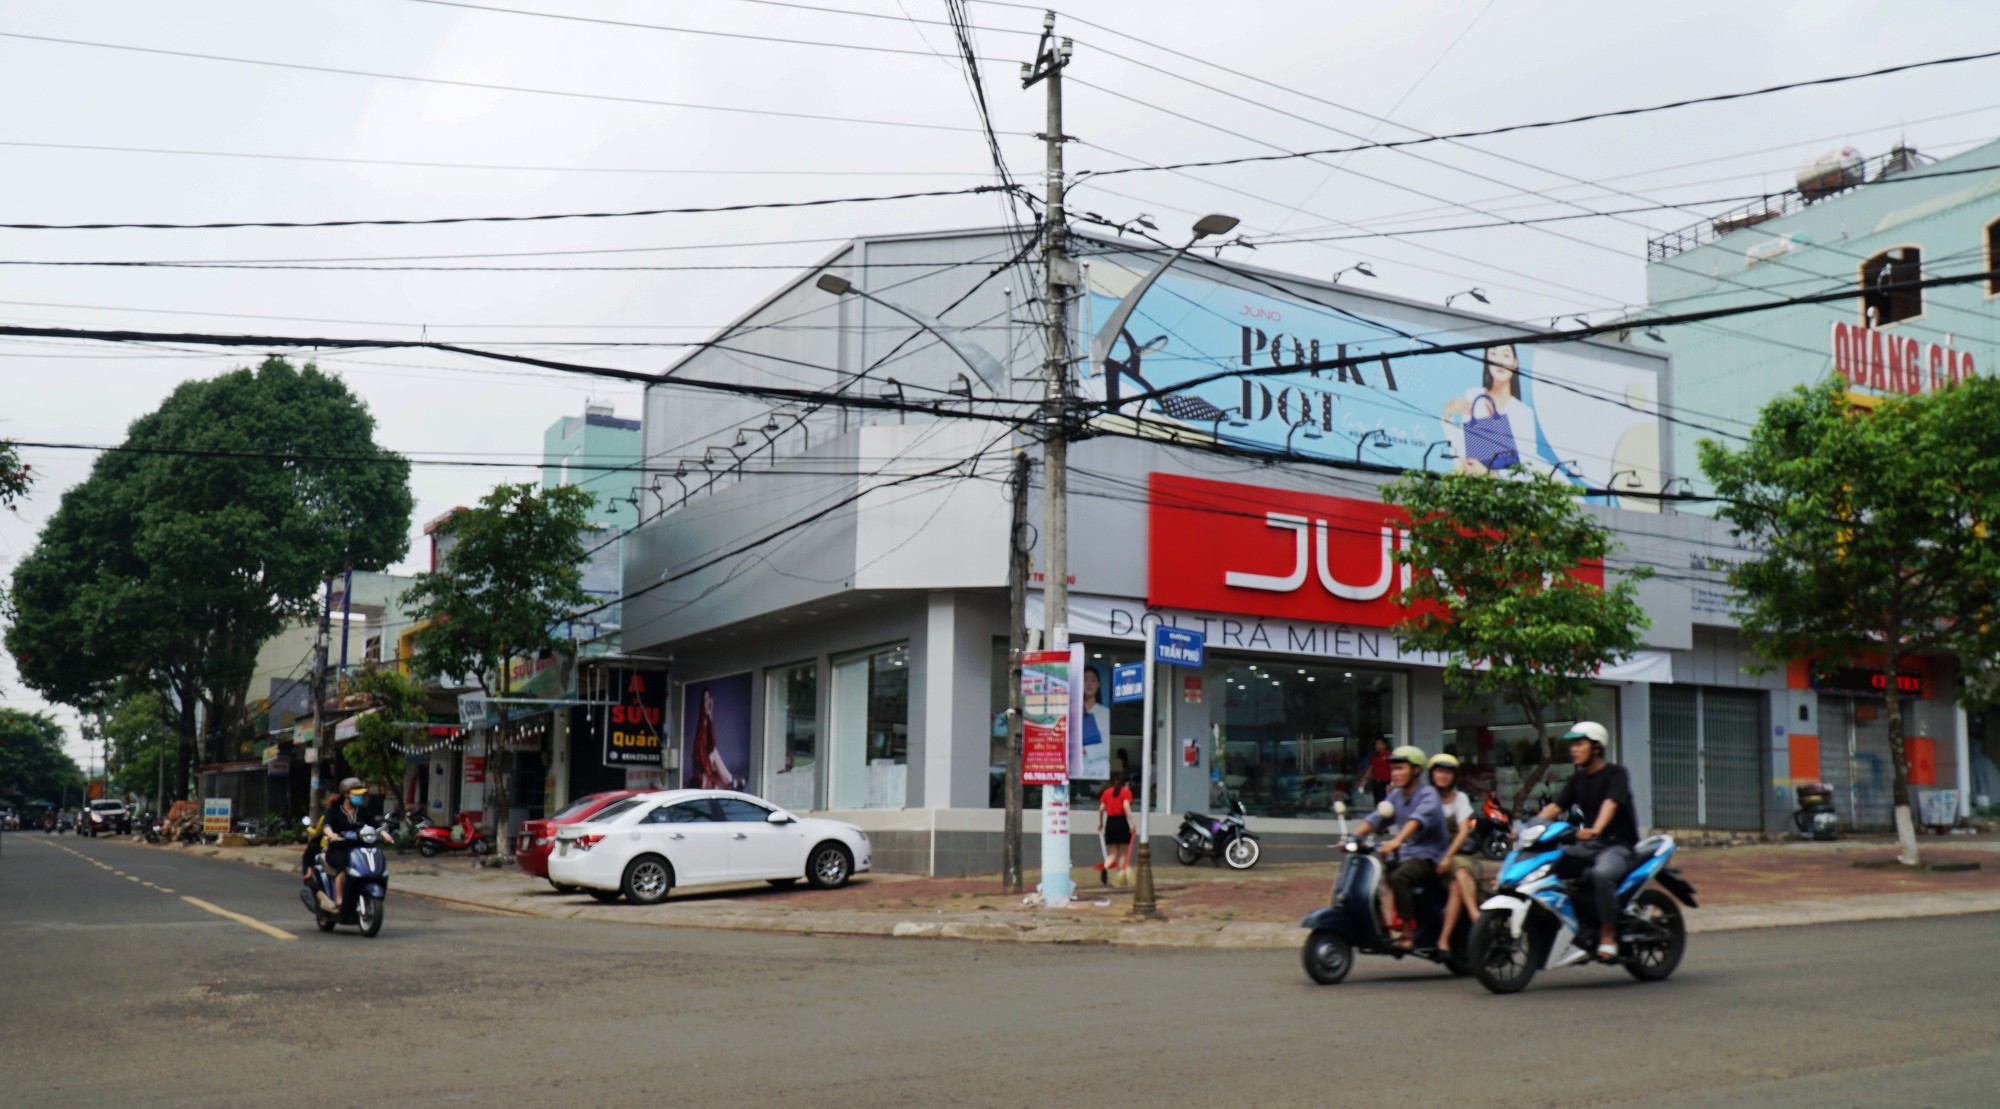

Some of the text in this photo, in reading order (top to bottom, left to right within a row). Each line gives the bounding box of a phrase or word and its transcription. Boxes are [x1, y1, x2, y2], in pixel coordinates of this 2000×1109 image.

[1239, 305, 1281, 322] JUNO
[1241, 326, 1398, 391] POLKA
[1242, 379, 1341, 432] DOT
[613, 730, 658, 748] Quán
